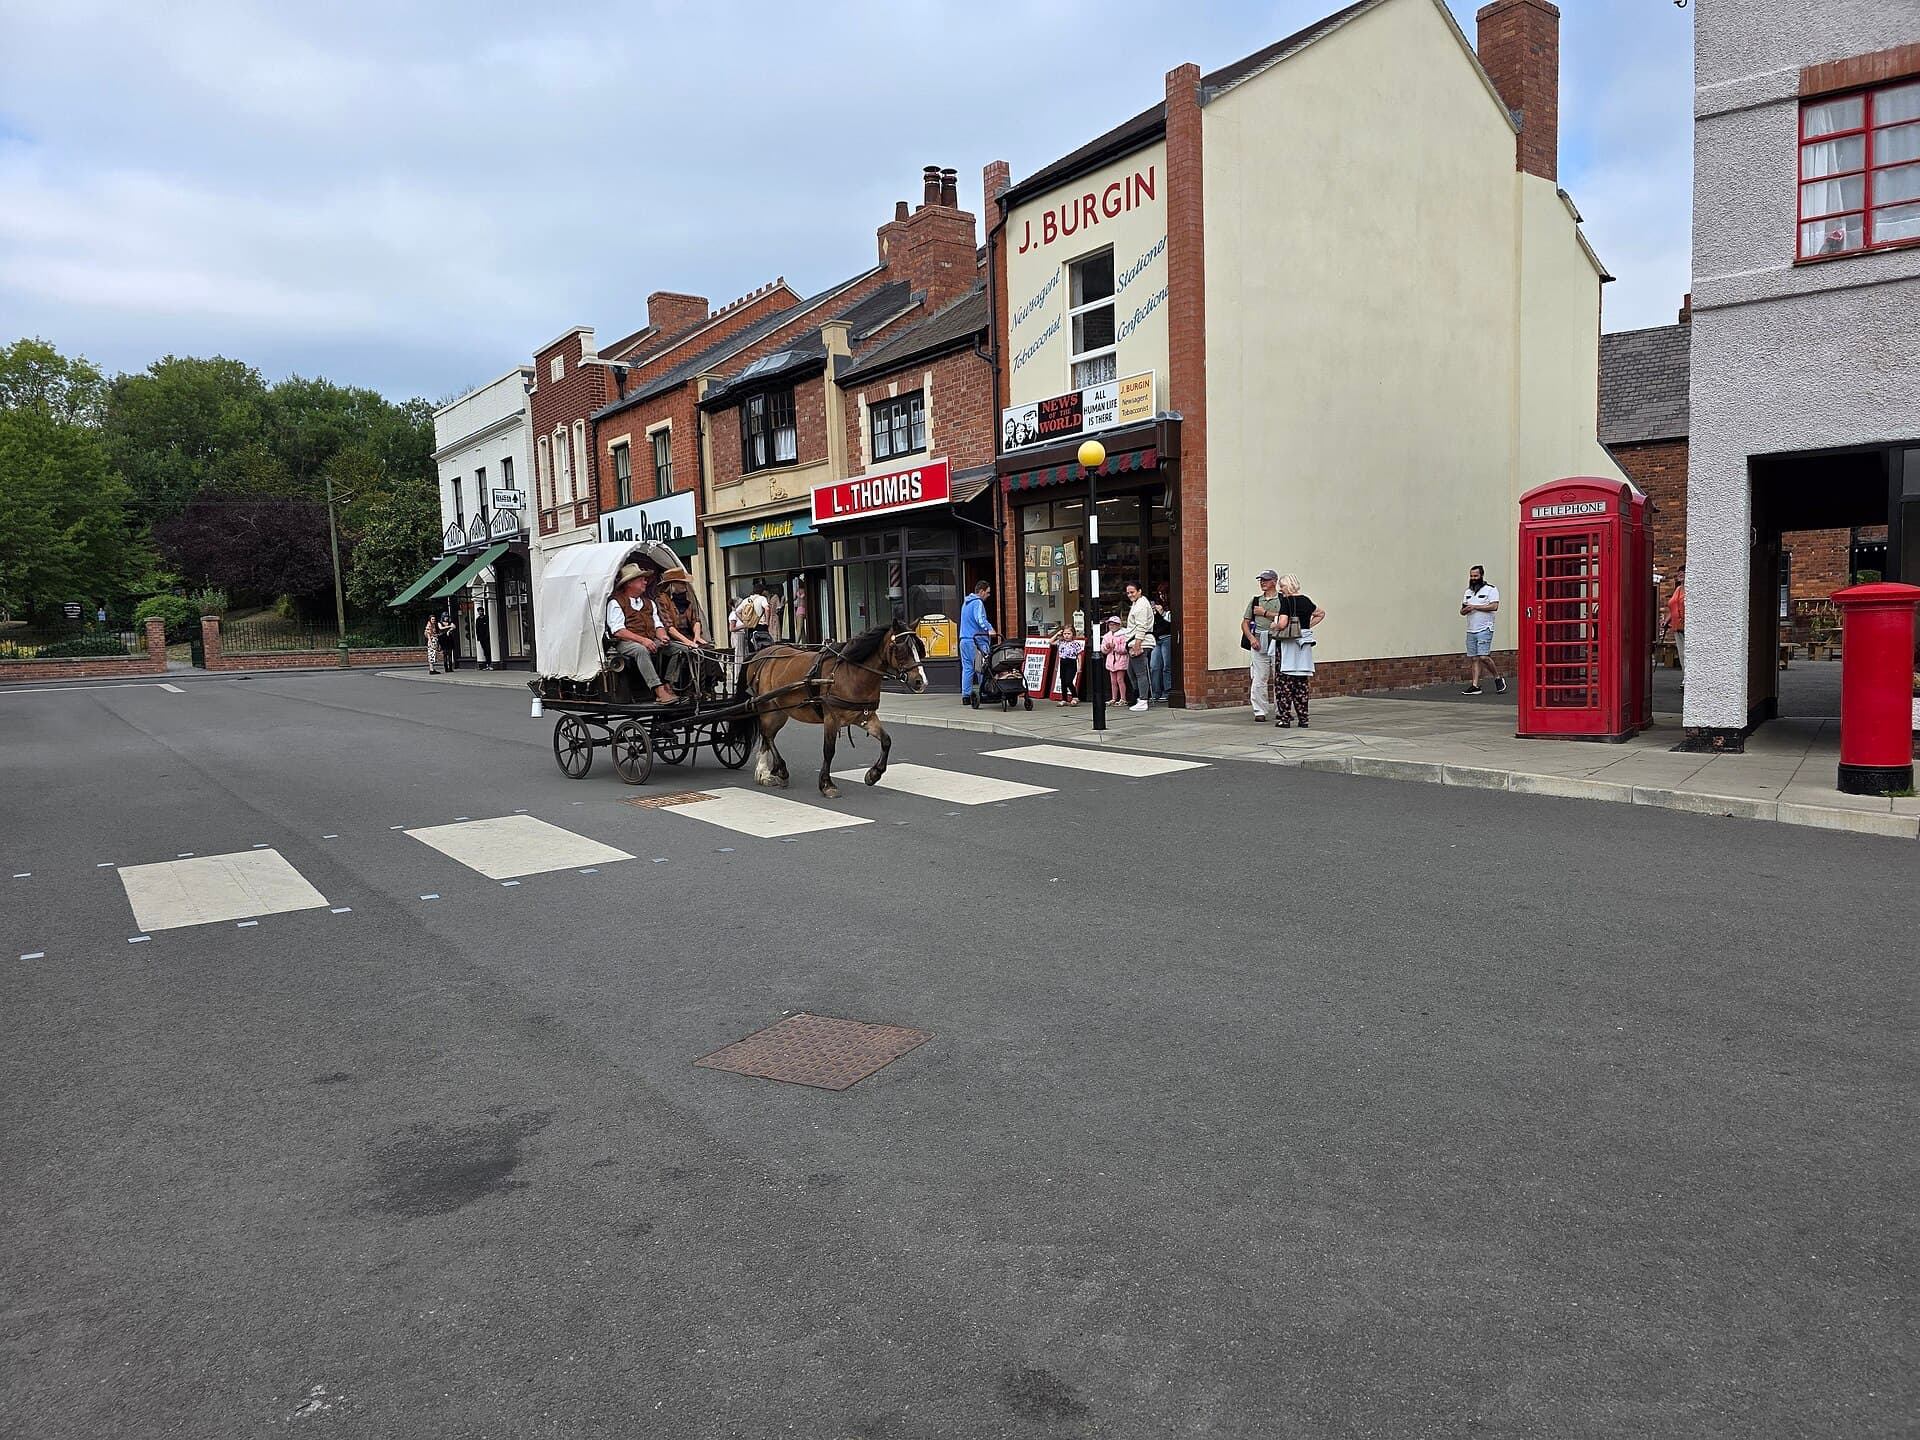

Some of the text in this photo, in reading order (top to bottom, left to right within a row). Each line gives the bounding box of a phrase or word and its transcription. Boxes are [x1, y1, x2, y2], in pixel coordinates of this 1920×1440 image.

[1011, 266, 1061, 332] Newsagent
[1013, 312, 1062, 374] Tobacconist
[1042, 394, 1078, 414] NEWS
[1095, 389, 1106, 401] ALL
[1049, 408, 1072, 419] OF THE
[1084, 398, 1118, 415] HUMAN LIFE
[1039, 413, 1082, 434] WORLD
[1089, 412, 1113, 426] IS THERE
[1535, 502, 1604, 517] TELEPHONE
[640, 509, 672, 543] BAXTER
